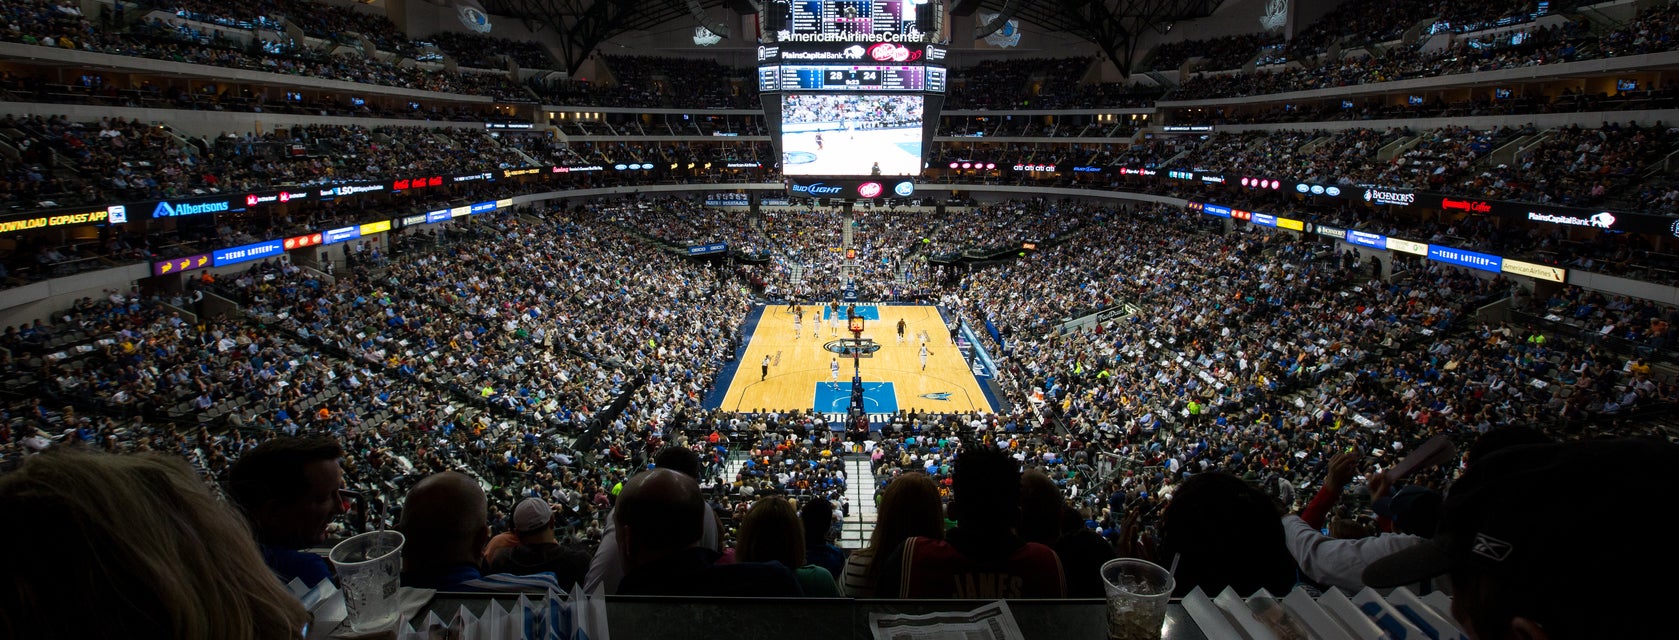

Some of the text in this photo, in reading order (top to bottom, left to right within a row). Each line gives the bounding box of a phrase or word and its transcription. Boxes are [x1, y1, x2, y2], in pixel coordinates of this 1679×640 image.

[829, 71, 843, 80] 28
[863, 71, 877, 80] 24
[175, 201, 228, 216] Albertsons
[88, 211, 108, 222] APP
[225, 245, 273, 260] TEXAS LOTTERY
[1439, 249, 1489, 266] TEXAS LOTTERY
[951, 572, 1024, 599] JAMES
